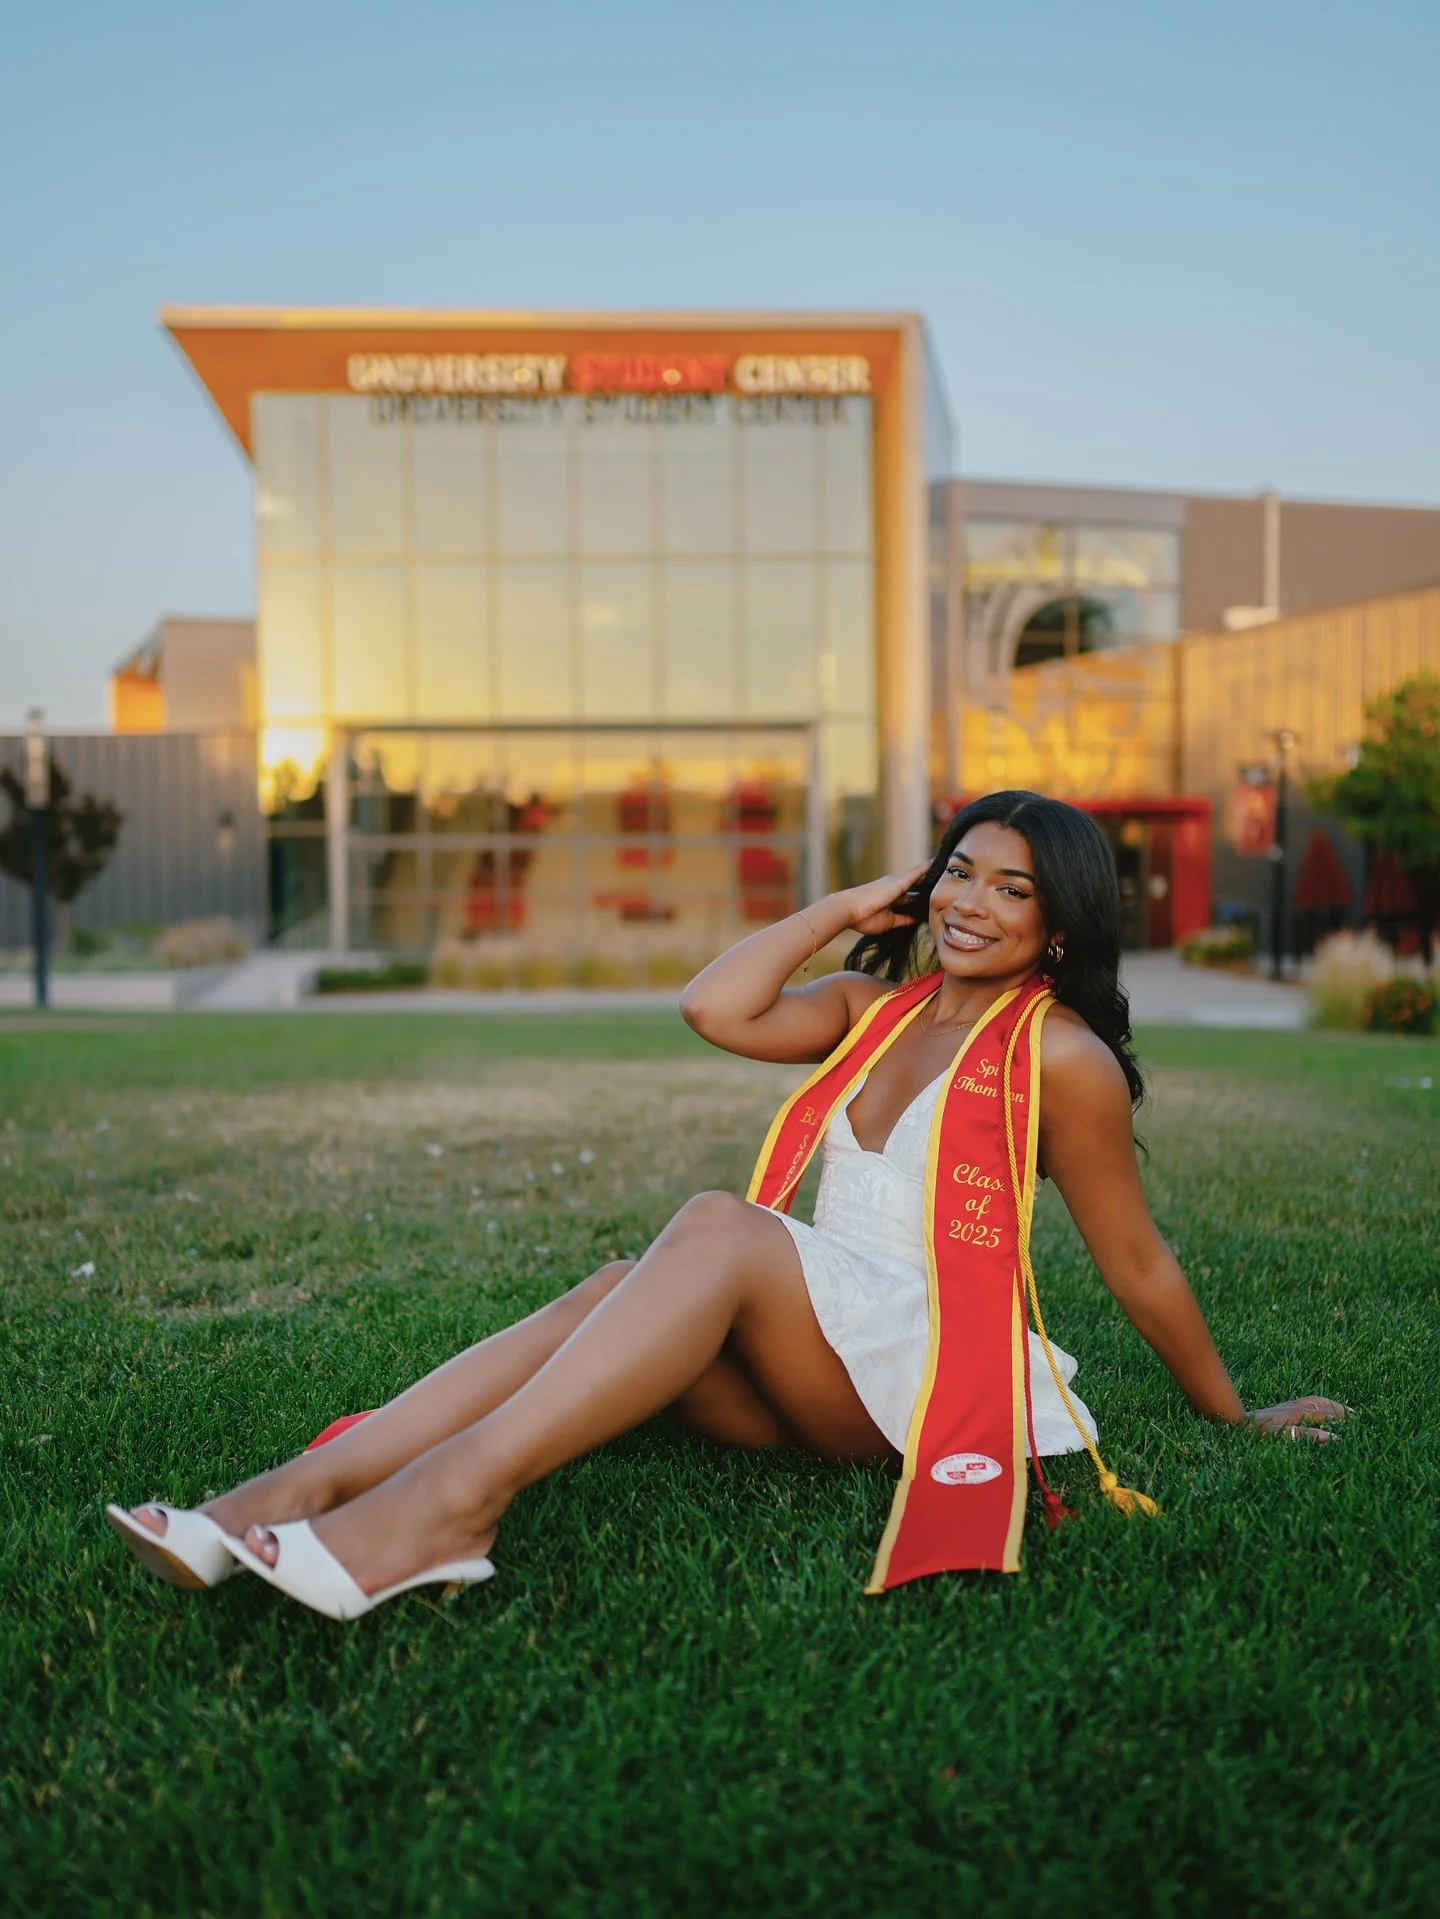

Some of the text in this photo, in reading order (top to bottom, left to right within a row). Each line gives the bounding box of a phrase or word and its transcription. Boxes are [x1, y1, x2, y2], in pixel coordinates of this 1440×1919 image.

[346, 352, 871, 392] UNIVERSITY STUDENT CENTER
[953, 1075, 1025, 1103] Thomon
[965, 1194, 992, 1220] of
[948, 1219, 1002, 1248] 2025
